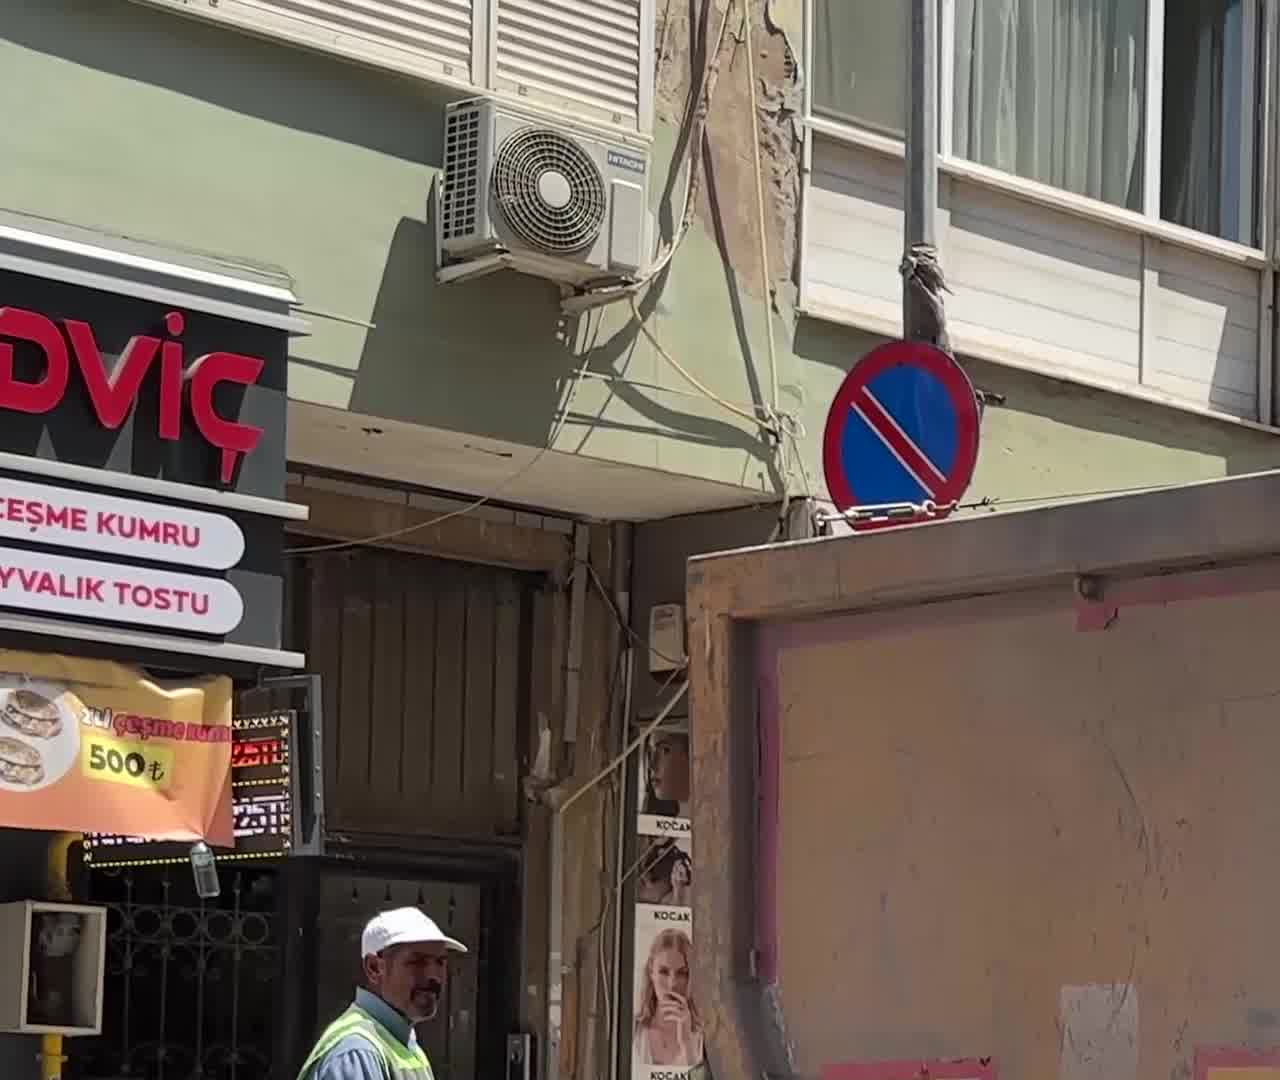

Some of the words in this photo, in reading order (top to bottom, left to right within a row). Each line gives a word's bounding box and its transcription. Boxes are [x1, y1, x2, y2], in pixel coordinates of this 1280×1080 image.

[97, 511, 200, 548] KUMRU
[114, 581, 209, 615] TOSTU
[89, 743, 146, 778] 500
